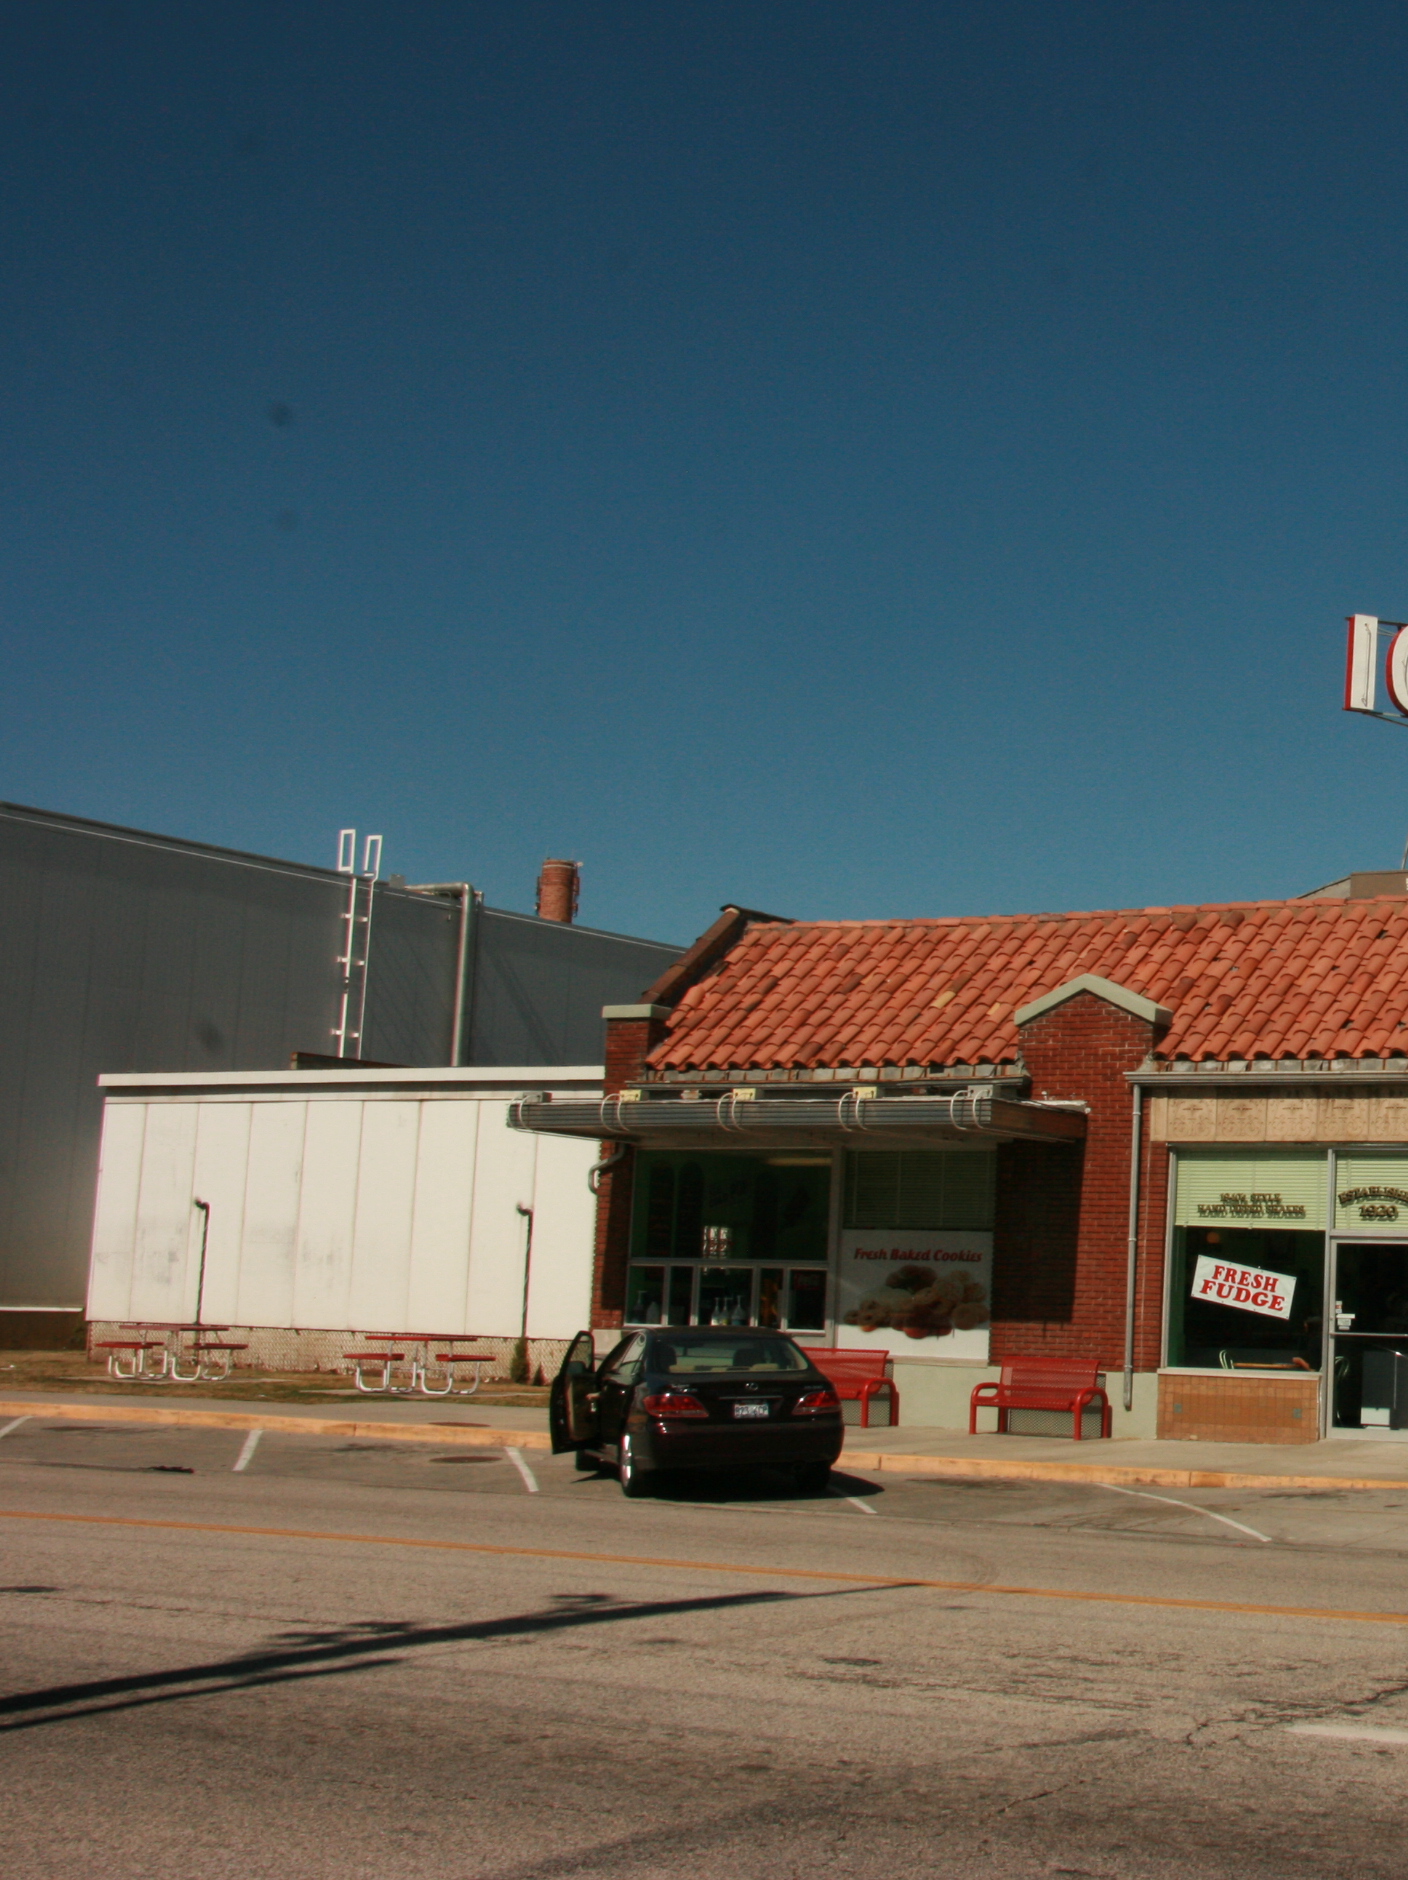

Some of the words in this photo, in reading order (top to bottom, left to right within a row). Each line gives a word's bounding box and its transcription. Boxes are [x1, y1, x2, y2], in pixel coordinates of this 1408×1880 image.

[1250, 1193, 1282, 1203] STYLE
[1266, 1204, 1305, 1215] SHAKES
[854, 1248, 887, 1260] Fresh
[890, 1249, 931, 1261] Baked
[933, 1249, 983, 1262] Cookies
[1212, 1264, 1279, 1294] FRESH
[1200, 1279, 1286, 1312] FUDGE
